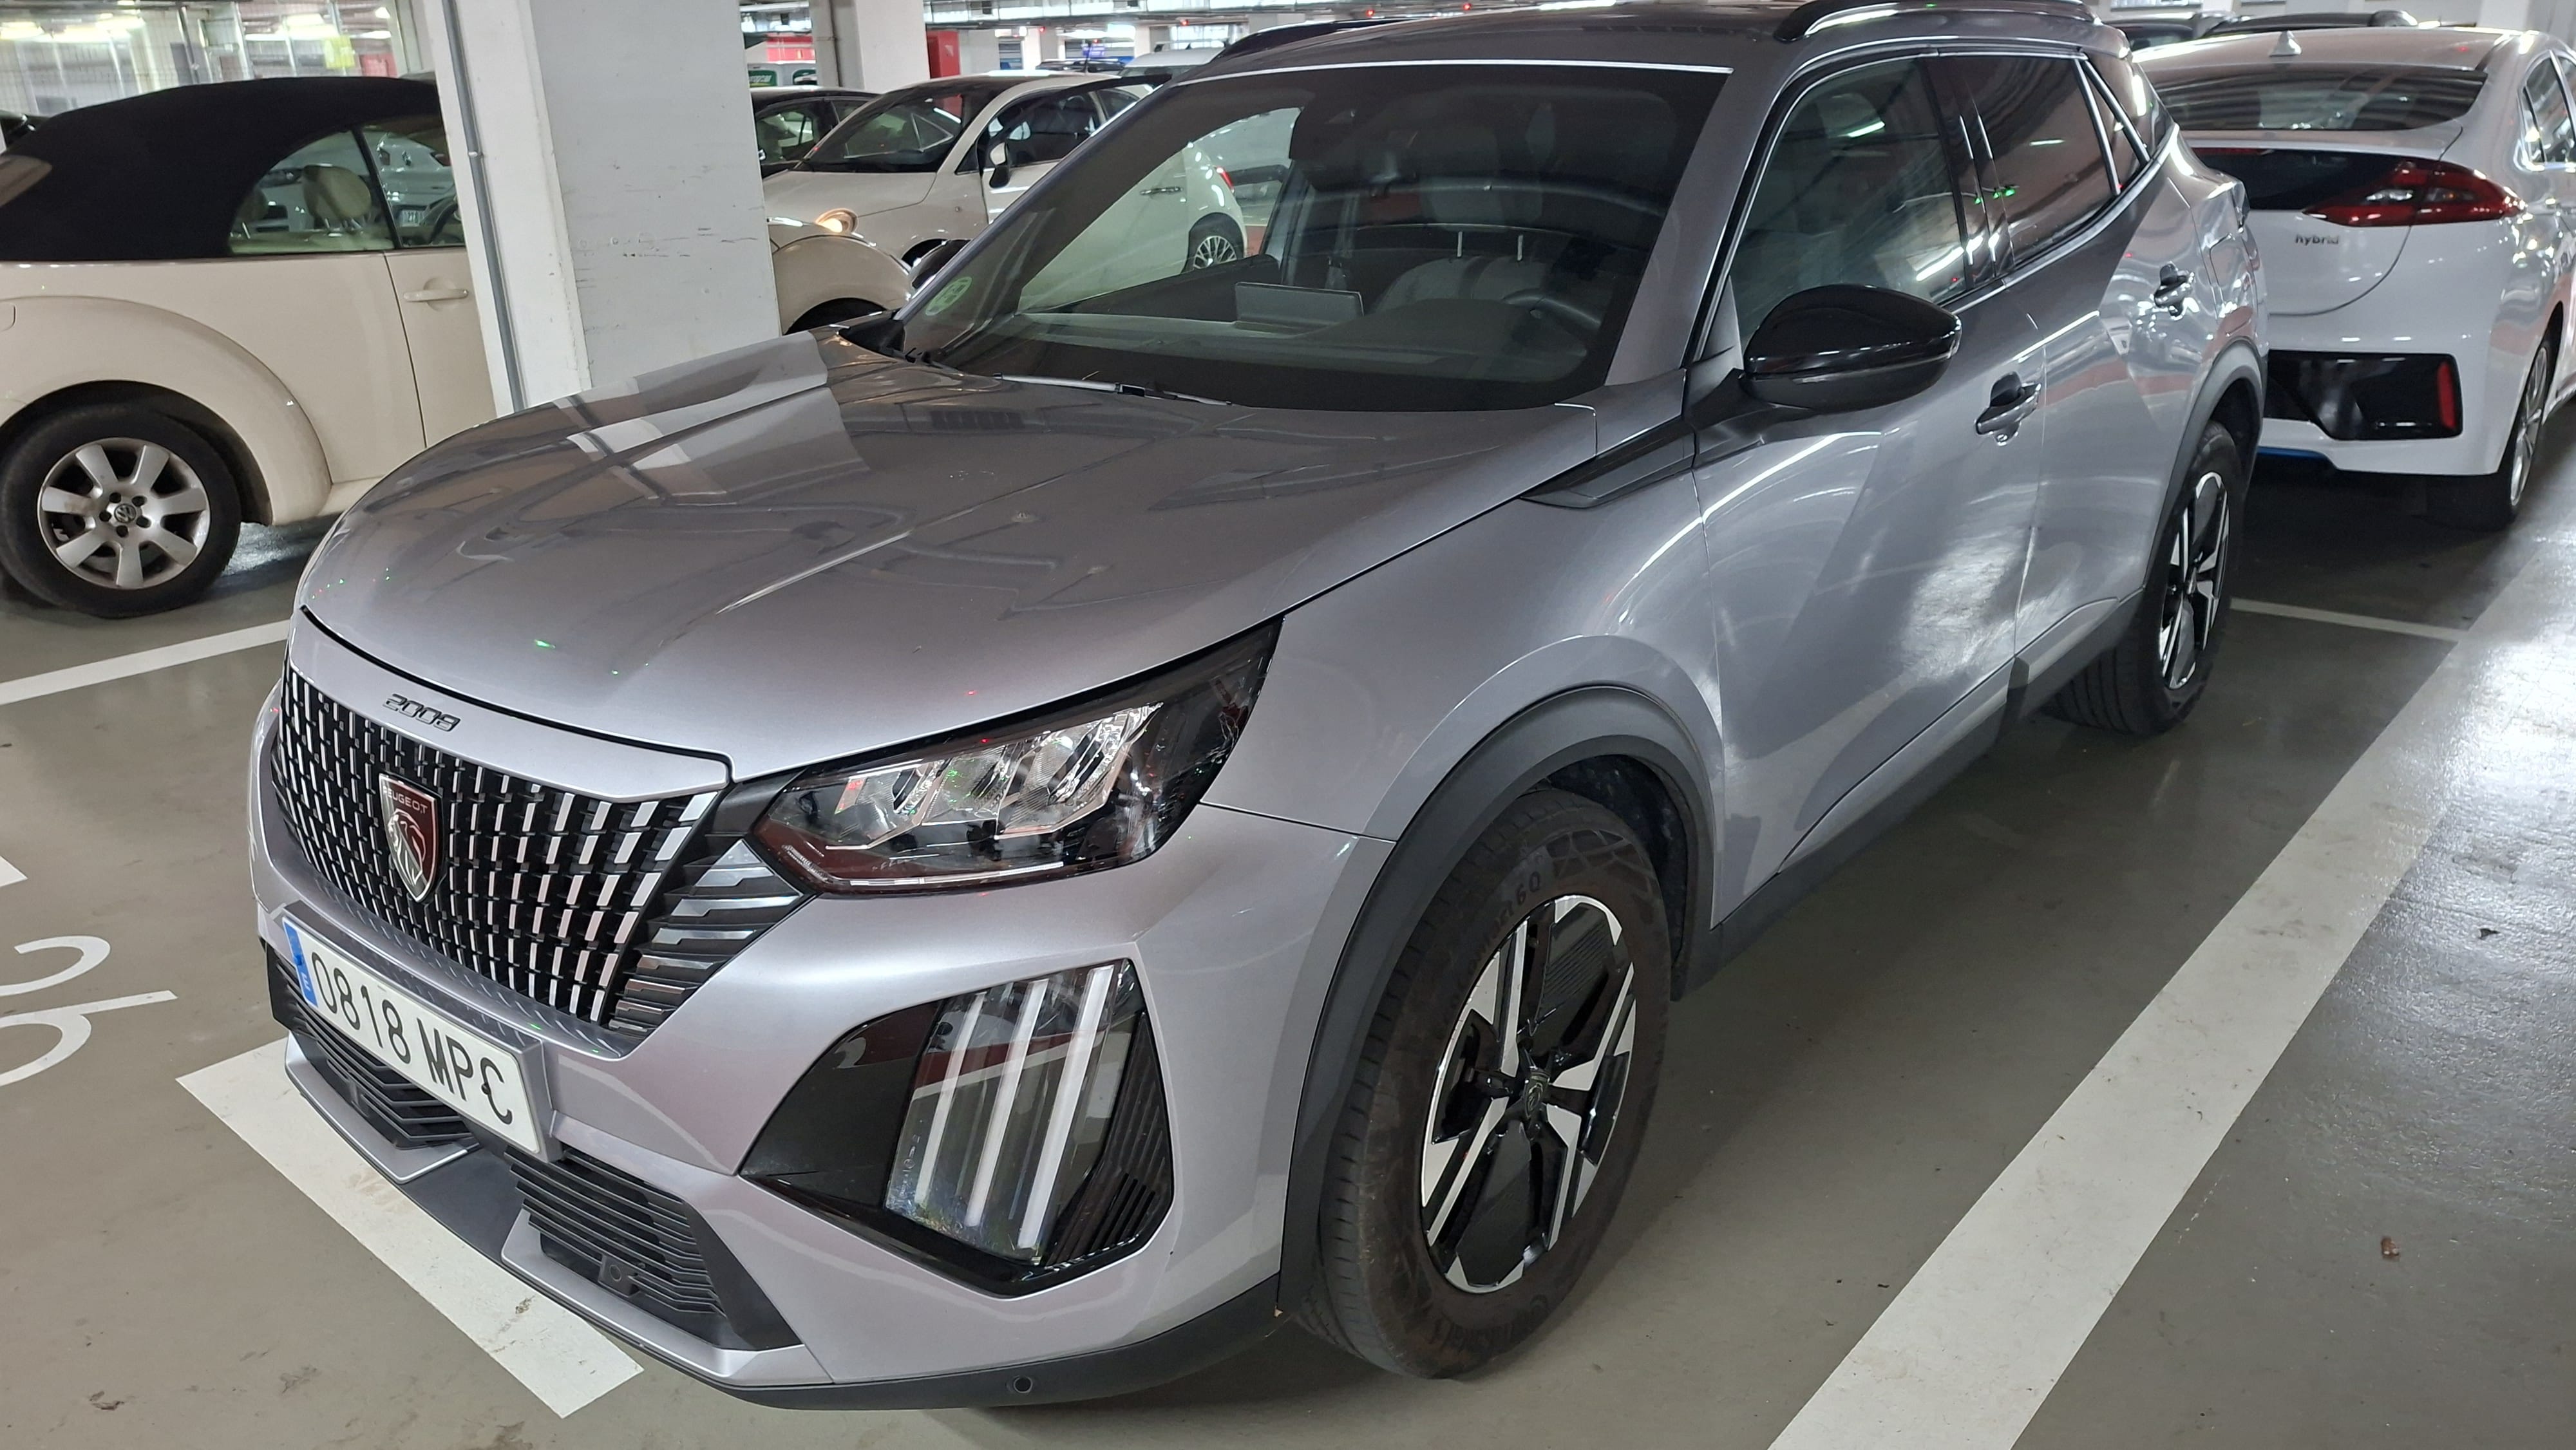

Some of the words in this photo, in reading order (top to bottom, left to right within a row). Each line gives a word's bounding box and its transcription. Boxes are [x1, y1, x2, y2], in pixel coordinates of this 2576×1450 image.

[2295, 234, 2340, 246] hybrid
[382, 693, 461, 732] 2008
[382, 785, 428, 814] PEUGEOT
[312, 951, 411, 1064] 0818
[417, 1017, 513, 1125] MPC
